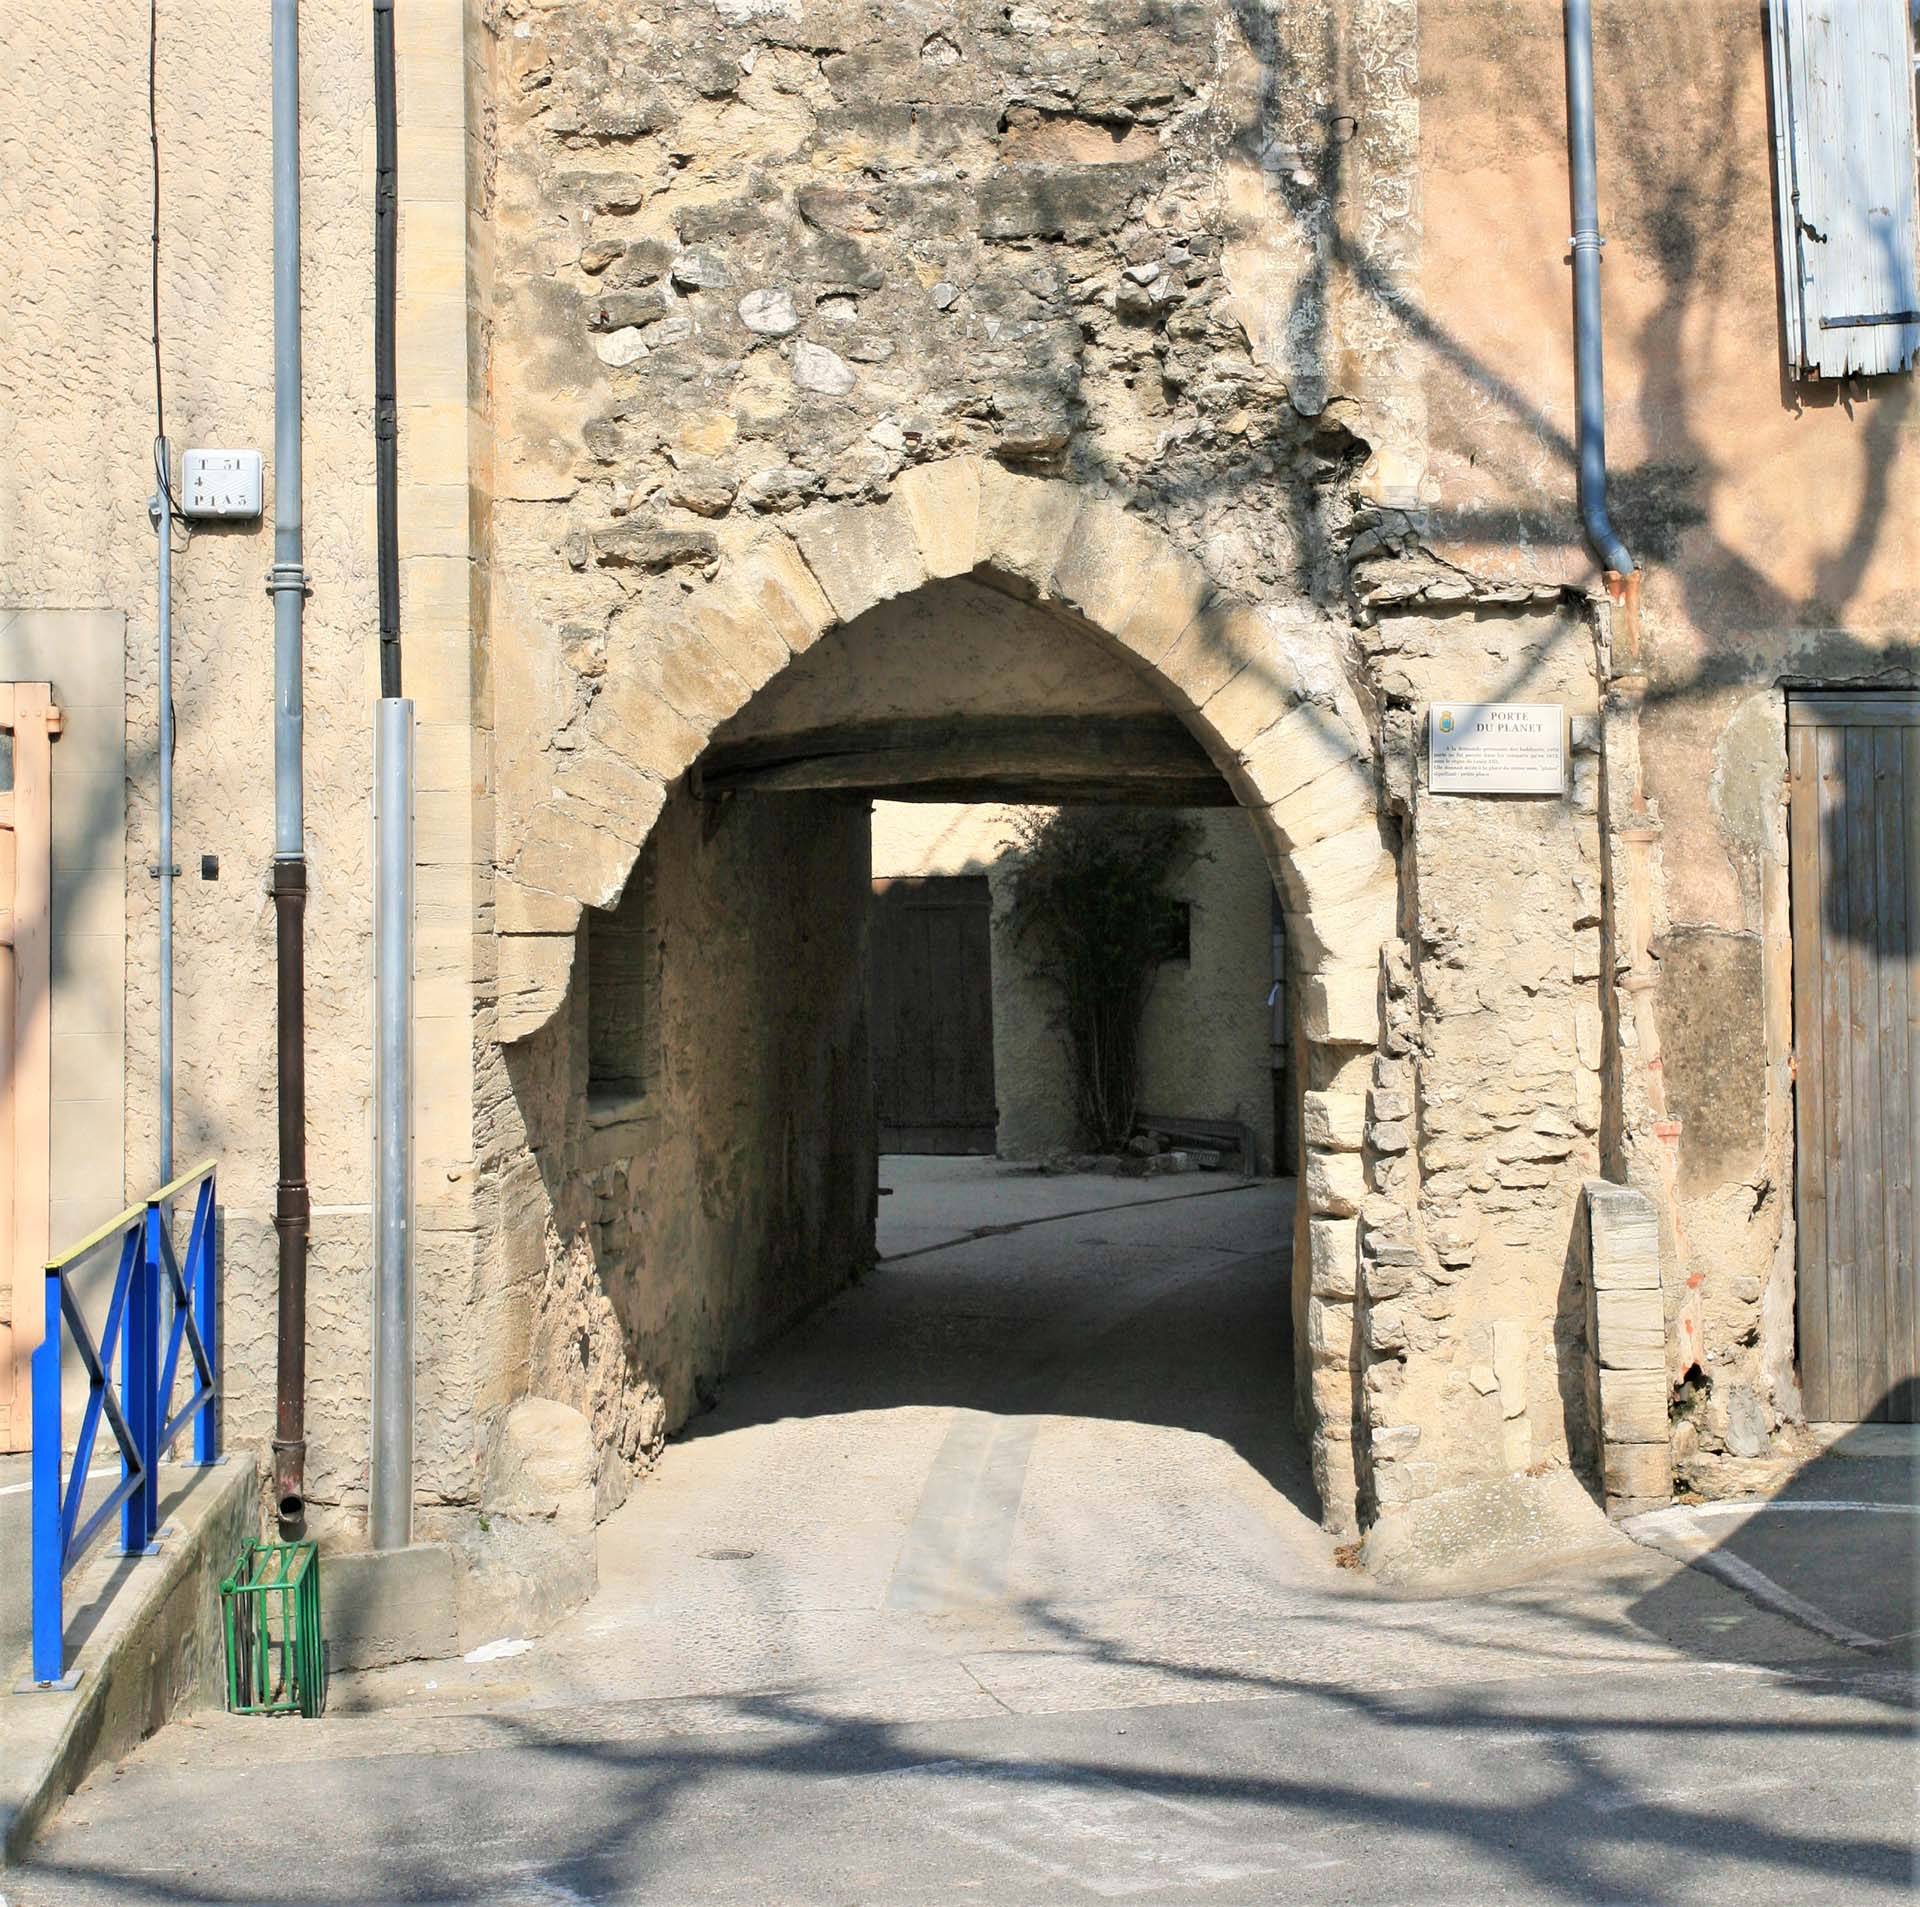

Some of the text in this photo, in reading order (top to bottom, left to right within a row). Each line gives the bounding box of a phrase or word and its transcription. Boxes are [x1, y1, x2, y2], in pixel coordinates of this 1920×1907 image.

[199, 459, 208, 470] T
[1491, 711, 1529, 721] PORTE
[1476, 723, 1543, 733] DU PLANET
